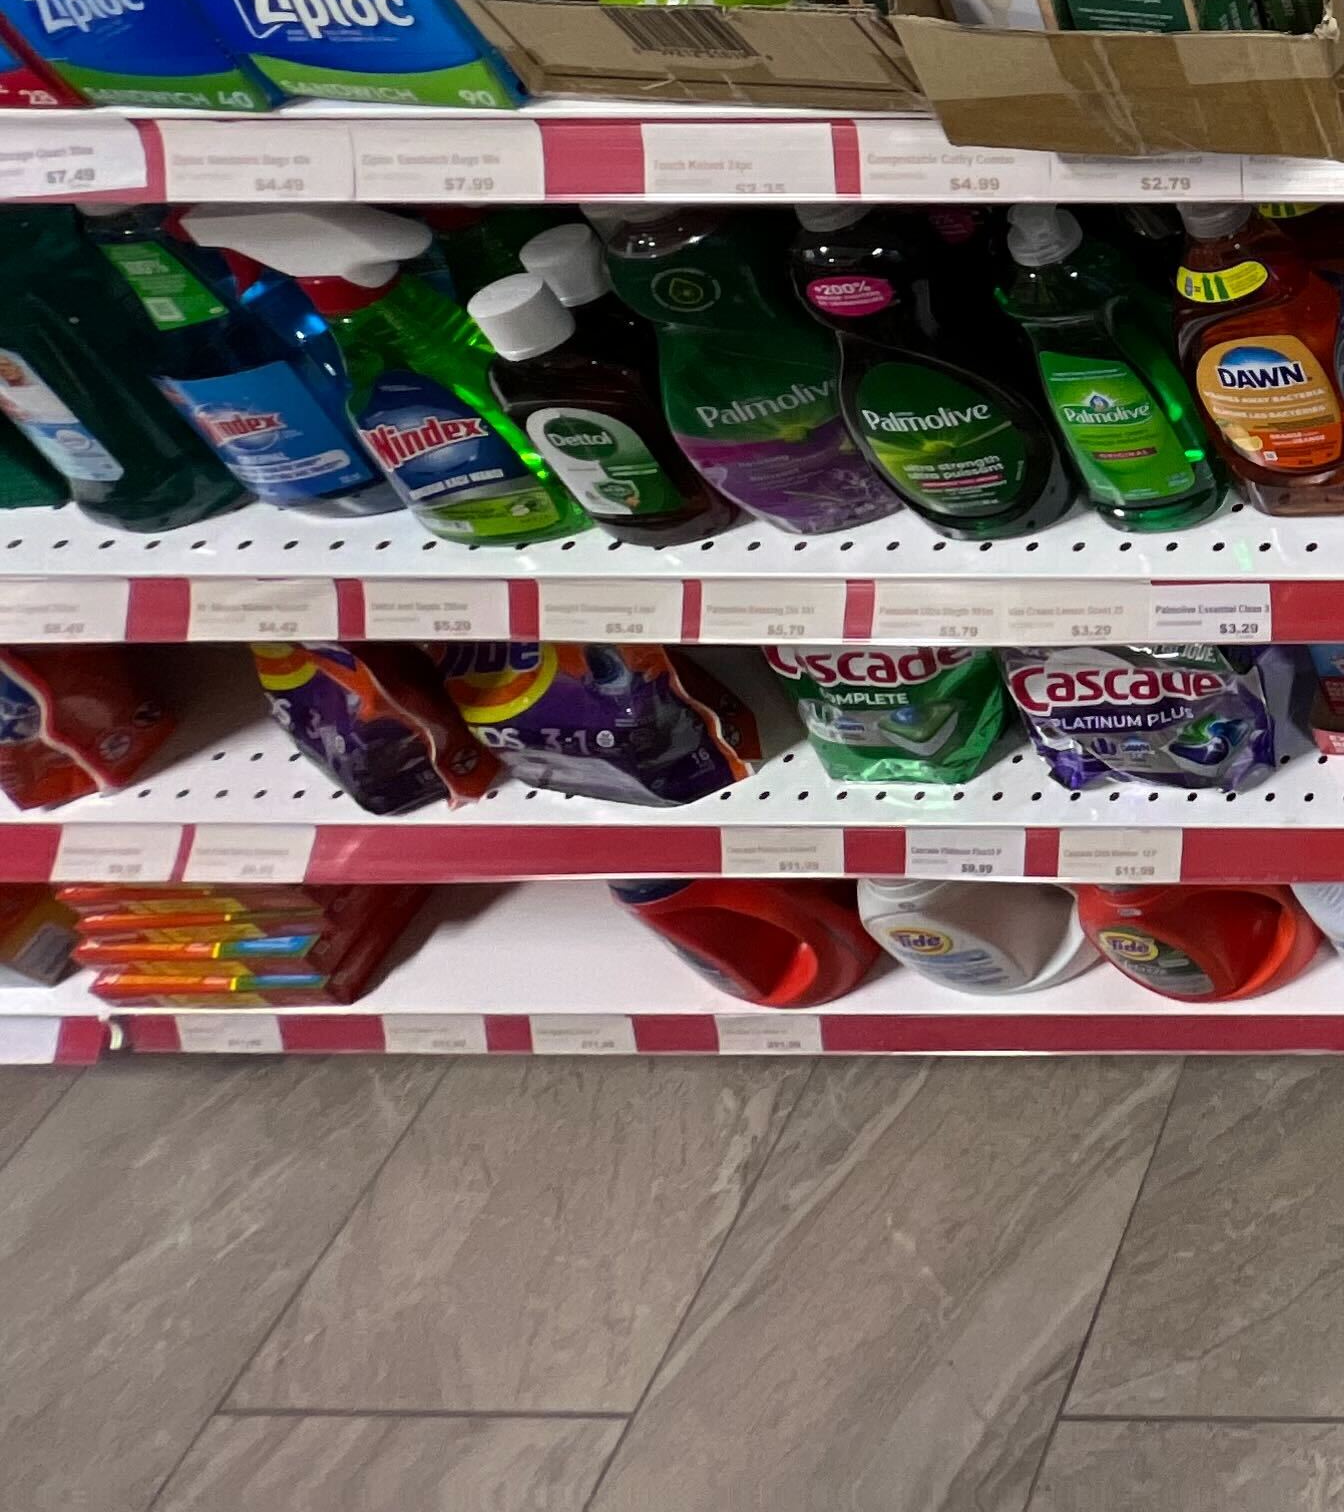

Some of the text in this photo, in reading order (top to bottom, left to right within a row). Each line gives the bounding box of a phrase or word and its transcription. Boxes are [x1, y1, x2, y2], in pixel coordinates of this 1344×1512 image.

[46, 168, 96, 185] $7.49
[443, 176, 495, 192] $7.99
[949, 177, 1001, 192] $4.99
[1140, 176, 1192, 192] $2.79
[1217, 364, 1304, 388] DAWN
[862, 402, 991, 434] Palmolive
[1064, 400, 1150, 425] Palmolive
[364, 417, 487, 470] Windex
[550, 430, 614, 450] Dettol
[1219, 622, 1259, 635] $3.29
[897, 931, 943, 950] Tide
[1106, 936, 1152, 954] Tide
